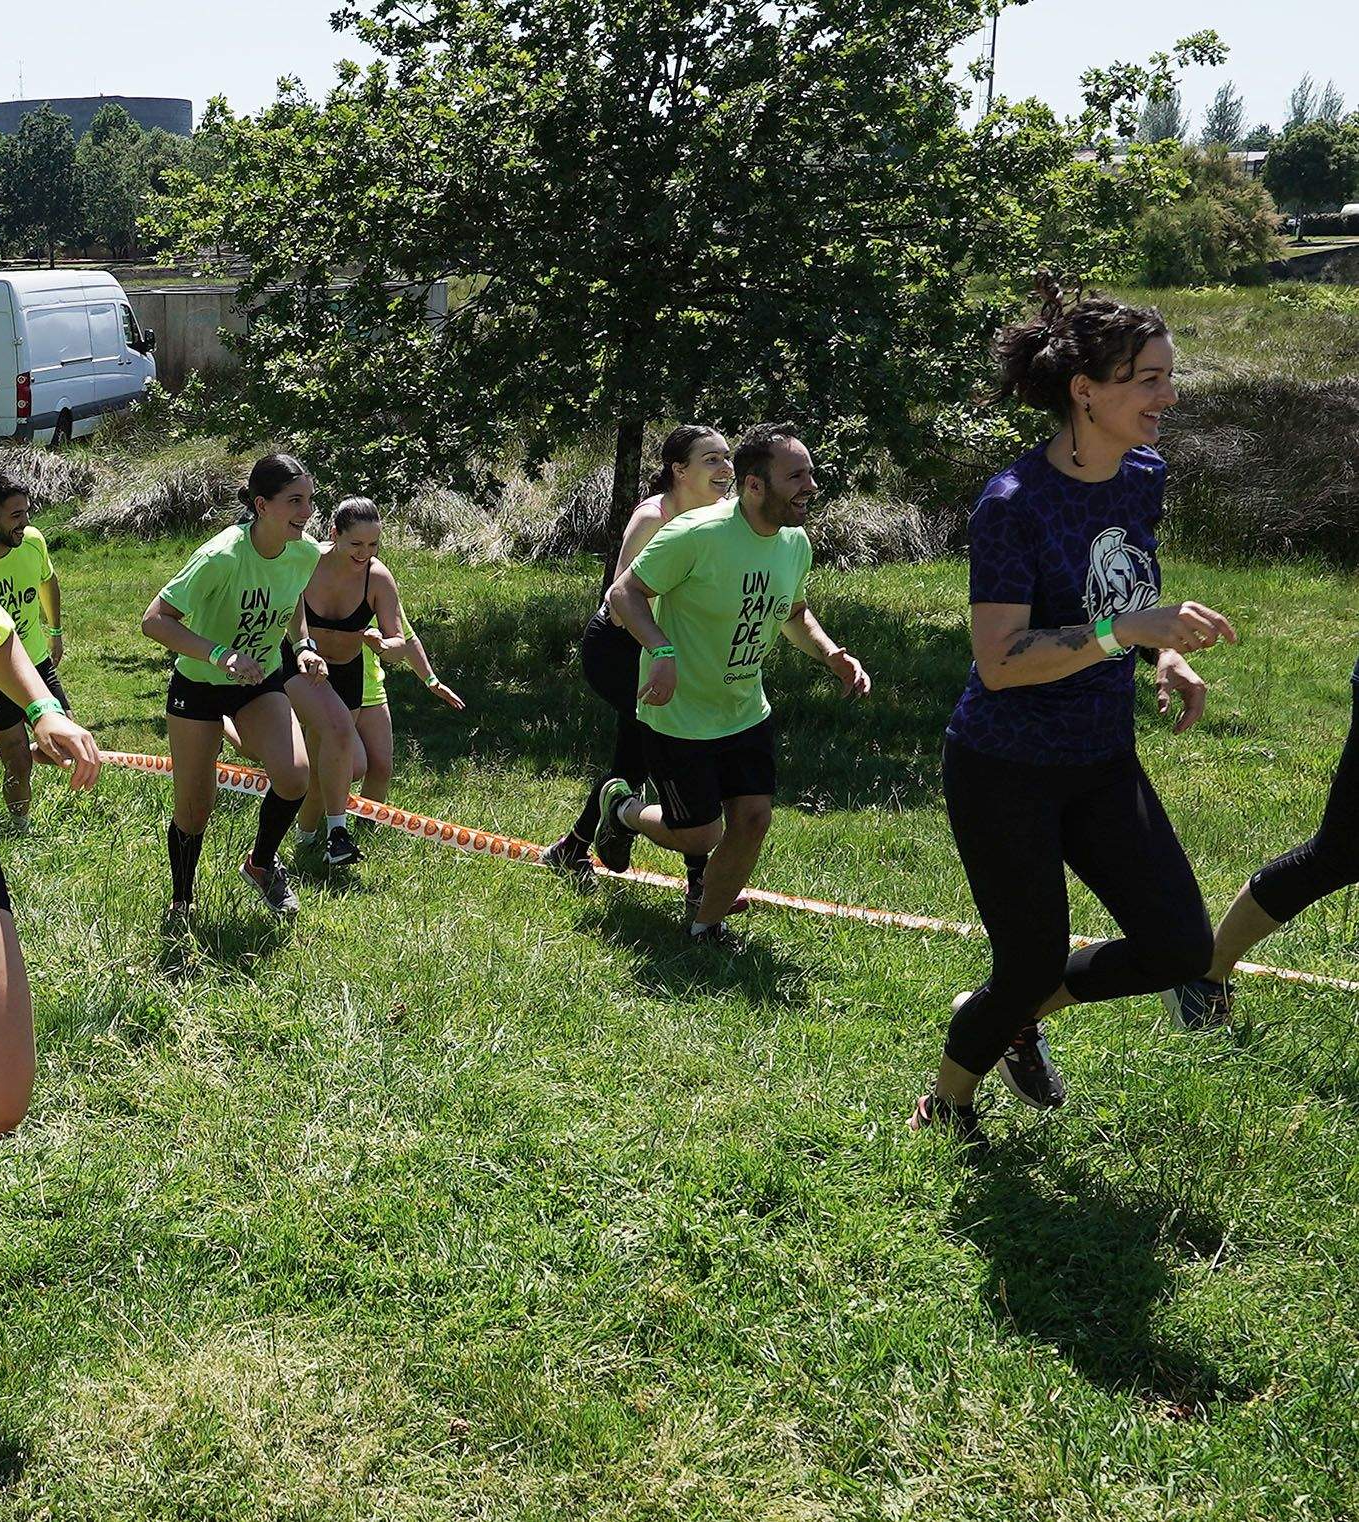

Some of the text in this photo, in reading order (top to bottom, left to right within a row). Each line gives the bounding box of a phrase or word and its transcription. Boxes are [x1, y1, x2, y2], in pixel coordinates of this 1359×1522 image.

[743, 570, 770, 595] UN
[240, 586, 271, 610] UN
[231, 631, 267, 651] DE
[732, 621, 763, 645] DE
